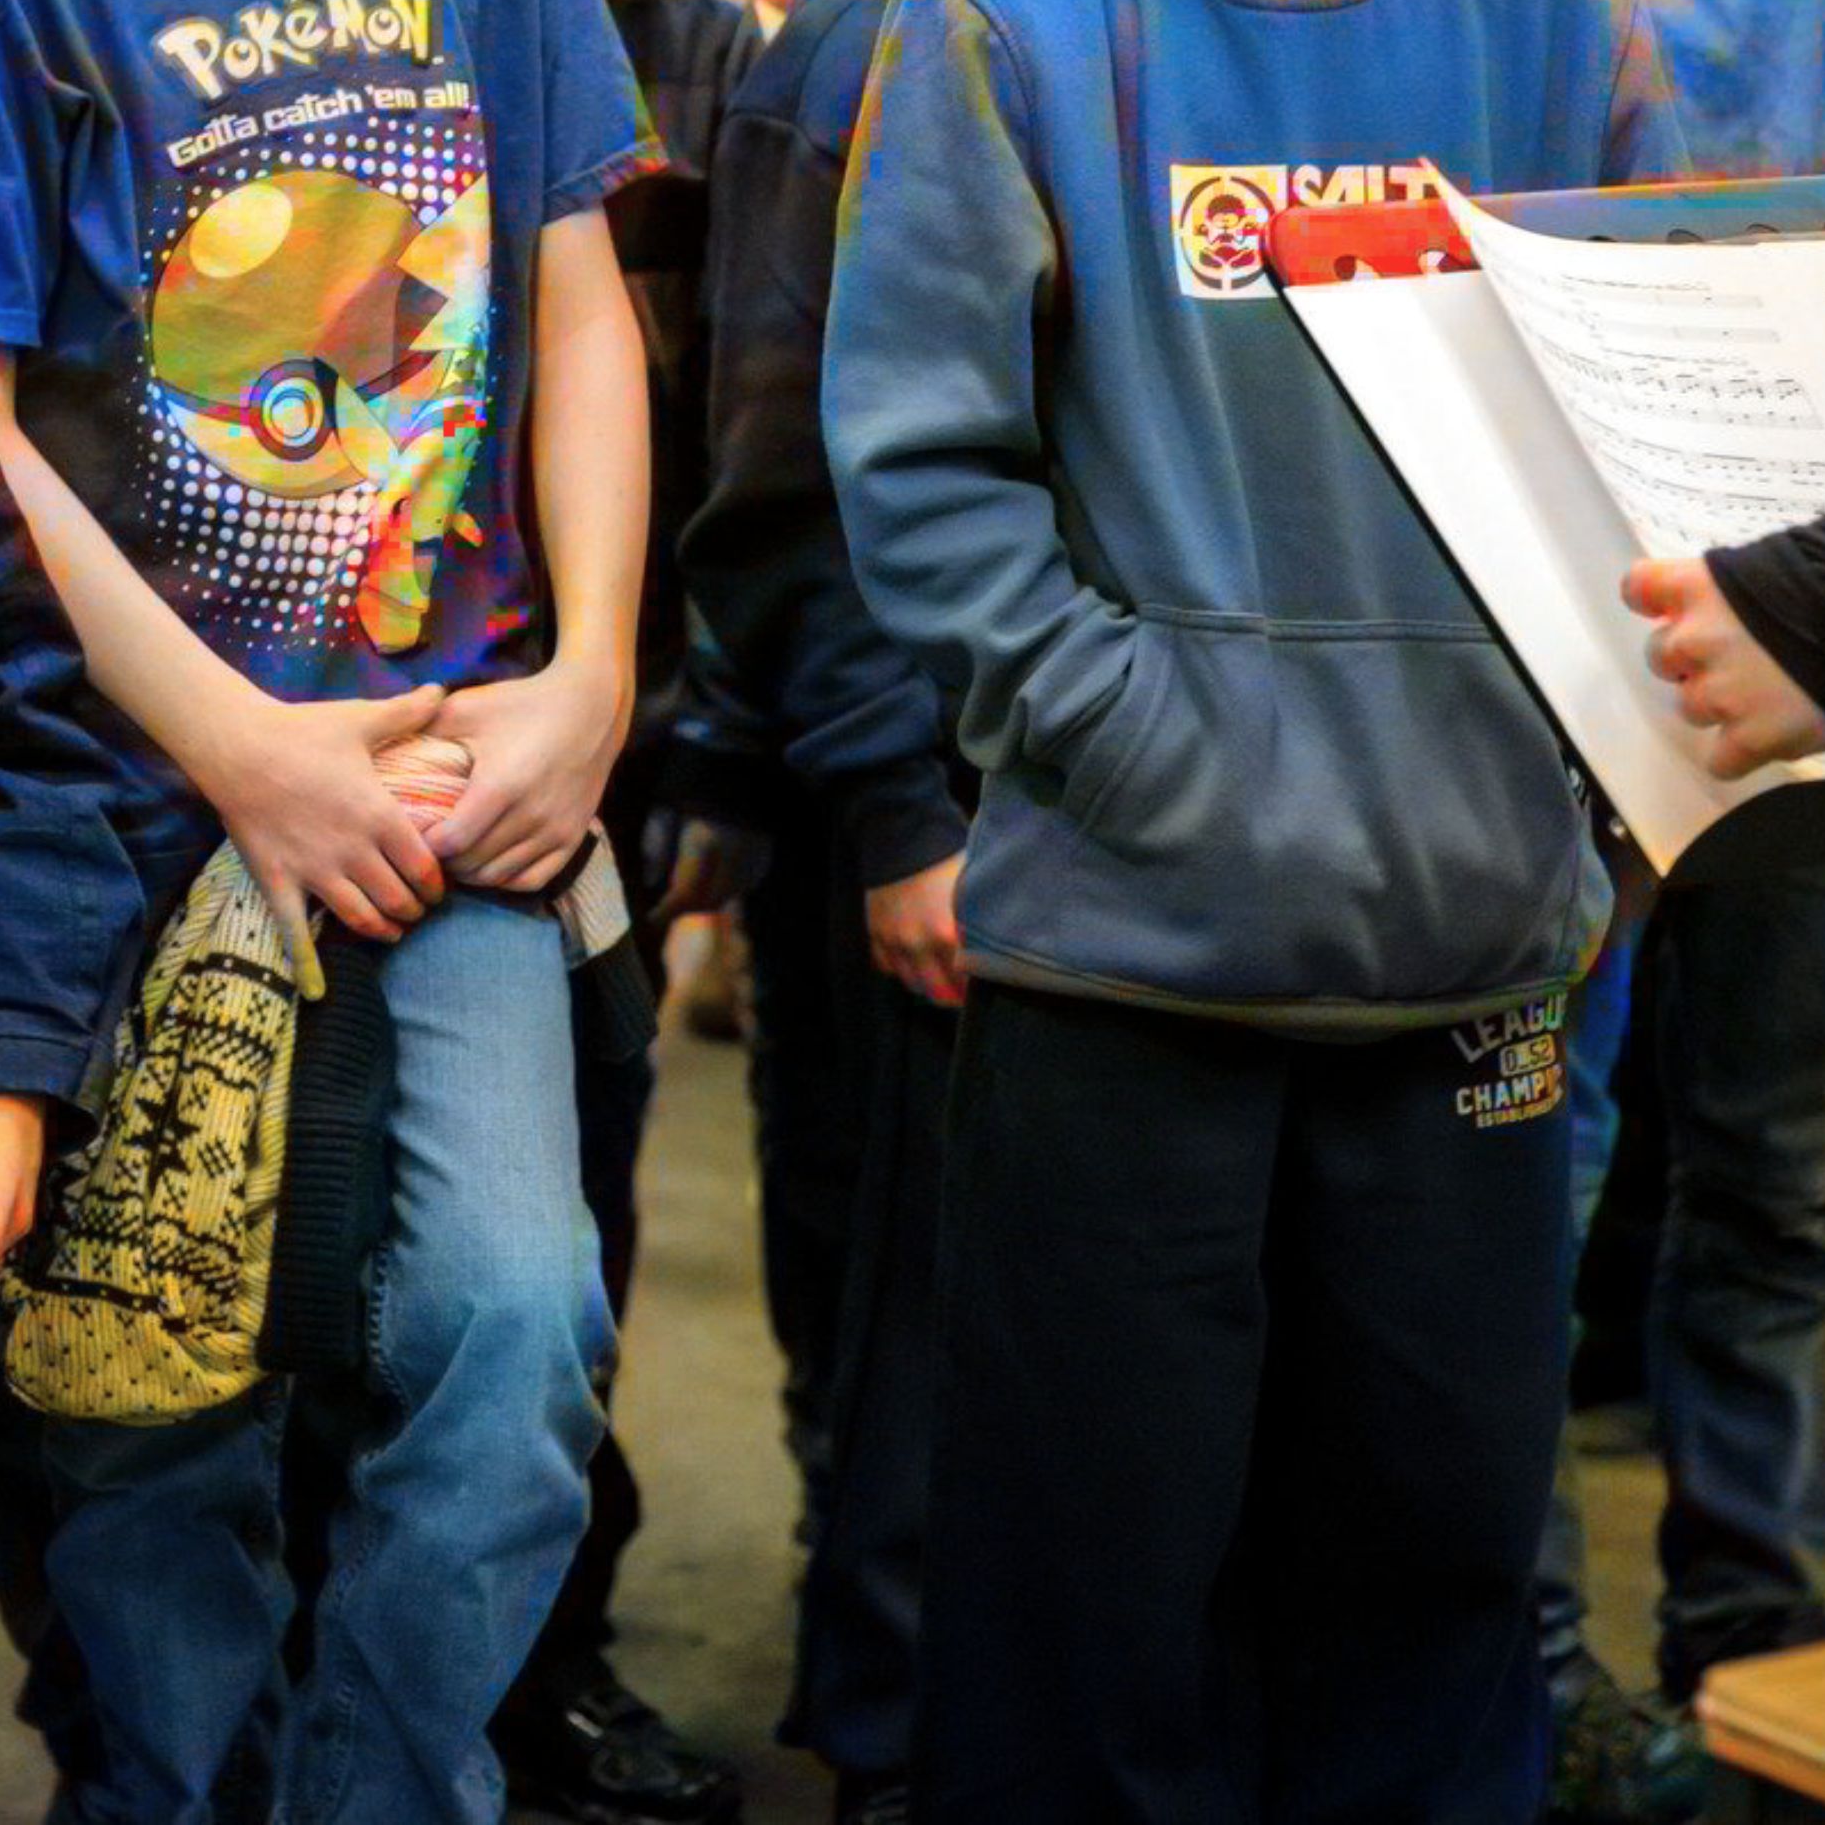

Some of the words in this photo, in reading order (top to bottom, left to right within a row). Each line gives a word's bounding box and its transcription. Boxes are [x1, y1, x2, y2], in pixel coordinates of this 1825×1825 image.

[167, 114, 259, 167] Gotta
[262, 85, 363, 130] catch
[1451, 991, 1568, 1063] LEAGU
